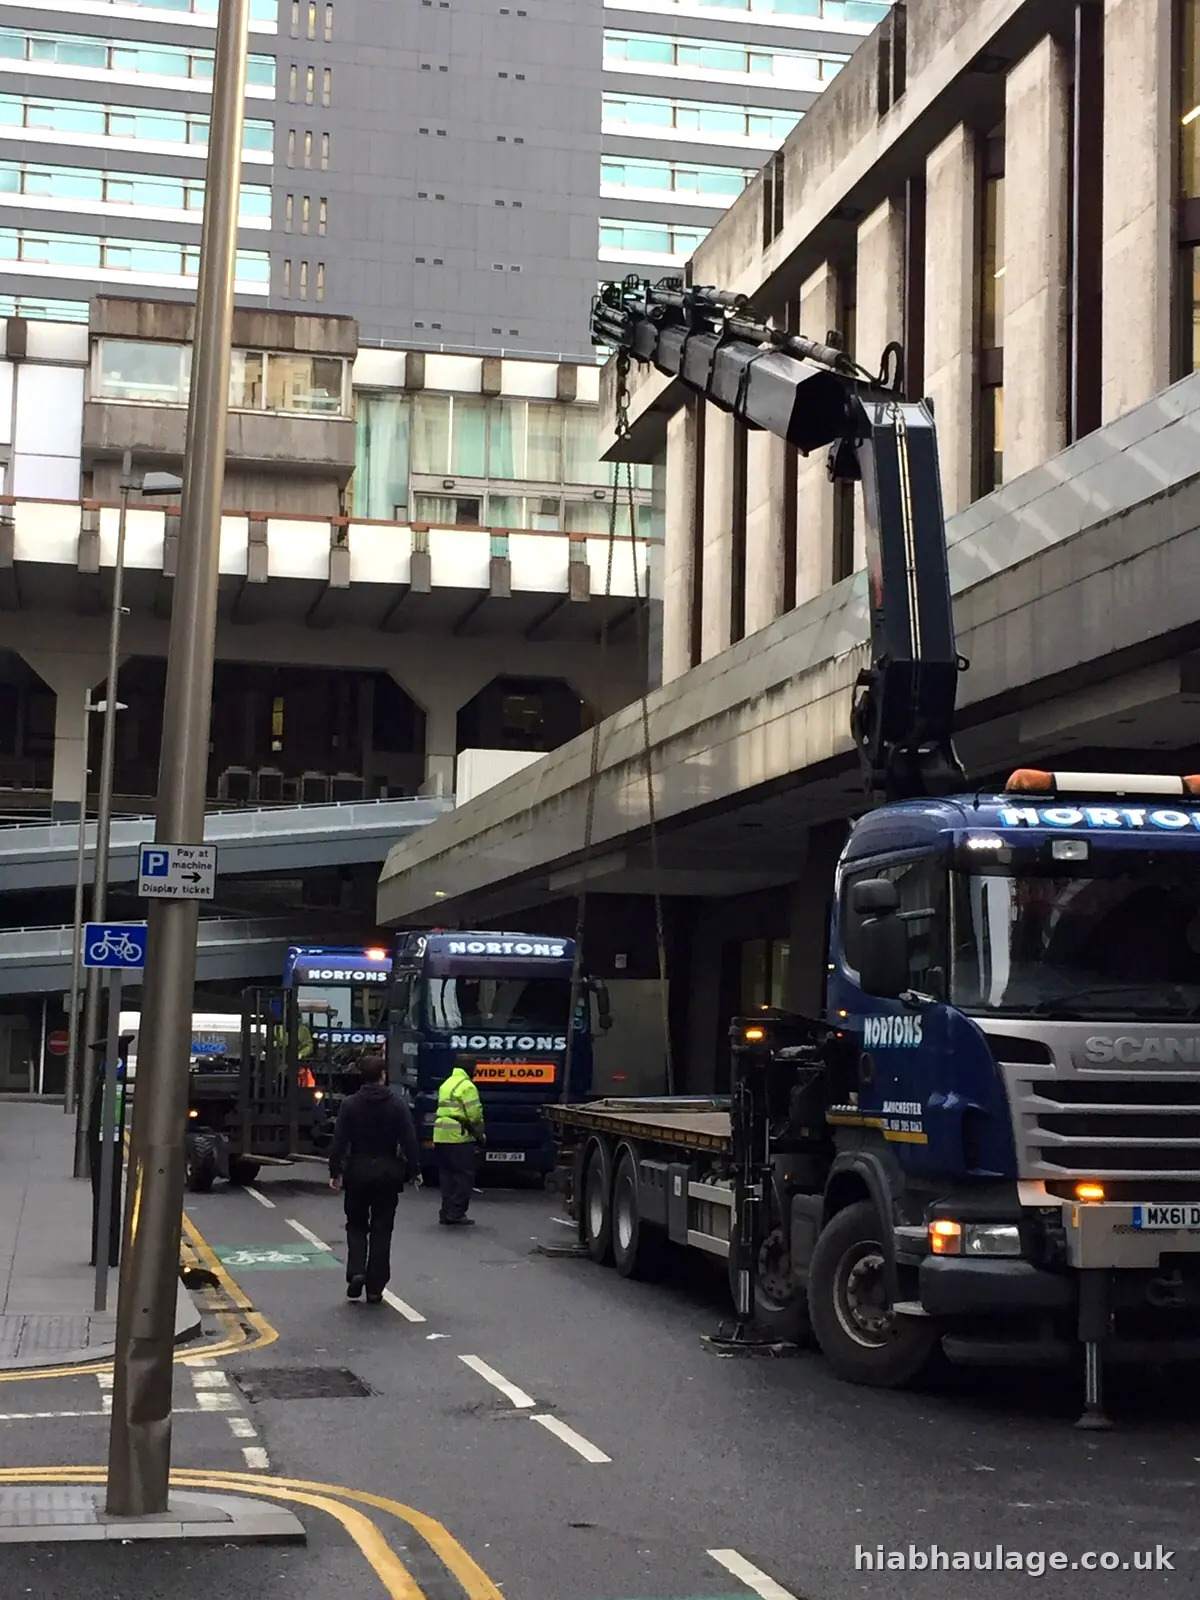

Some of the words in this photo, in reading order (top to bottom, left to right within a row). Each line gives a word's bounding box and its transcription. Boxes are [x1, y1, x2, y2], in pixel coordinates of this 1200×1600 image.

[998, 807, 1200, 829] NORTO
[176, 848, 194, 859] Pay
[198, 849, 209, 858] at
[148, 853, 165, 874] P
[172, 860, 212, 870] machine
[142, 884, 178, 895] Display
[182, 884, 210, 894] ticket
[450, 941, 565, 957] NORTONS
[308, 969, 387, 981] NORTONS
[863, 1014, 923, 1048] NORTONS
[450, 1035, 567, 1050] NORTONS
[509, 1069, 544, 1078] LOAD
[1147, 1207, 1186, 1225] MX61
